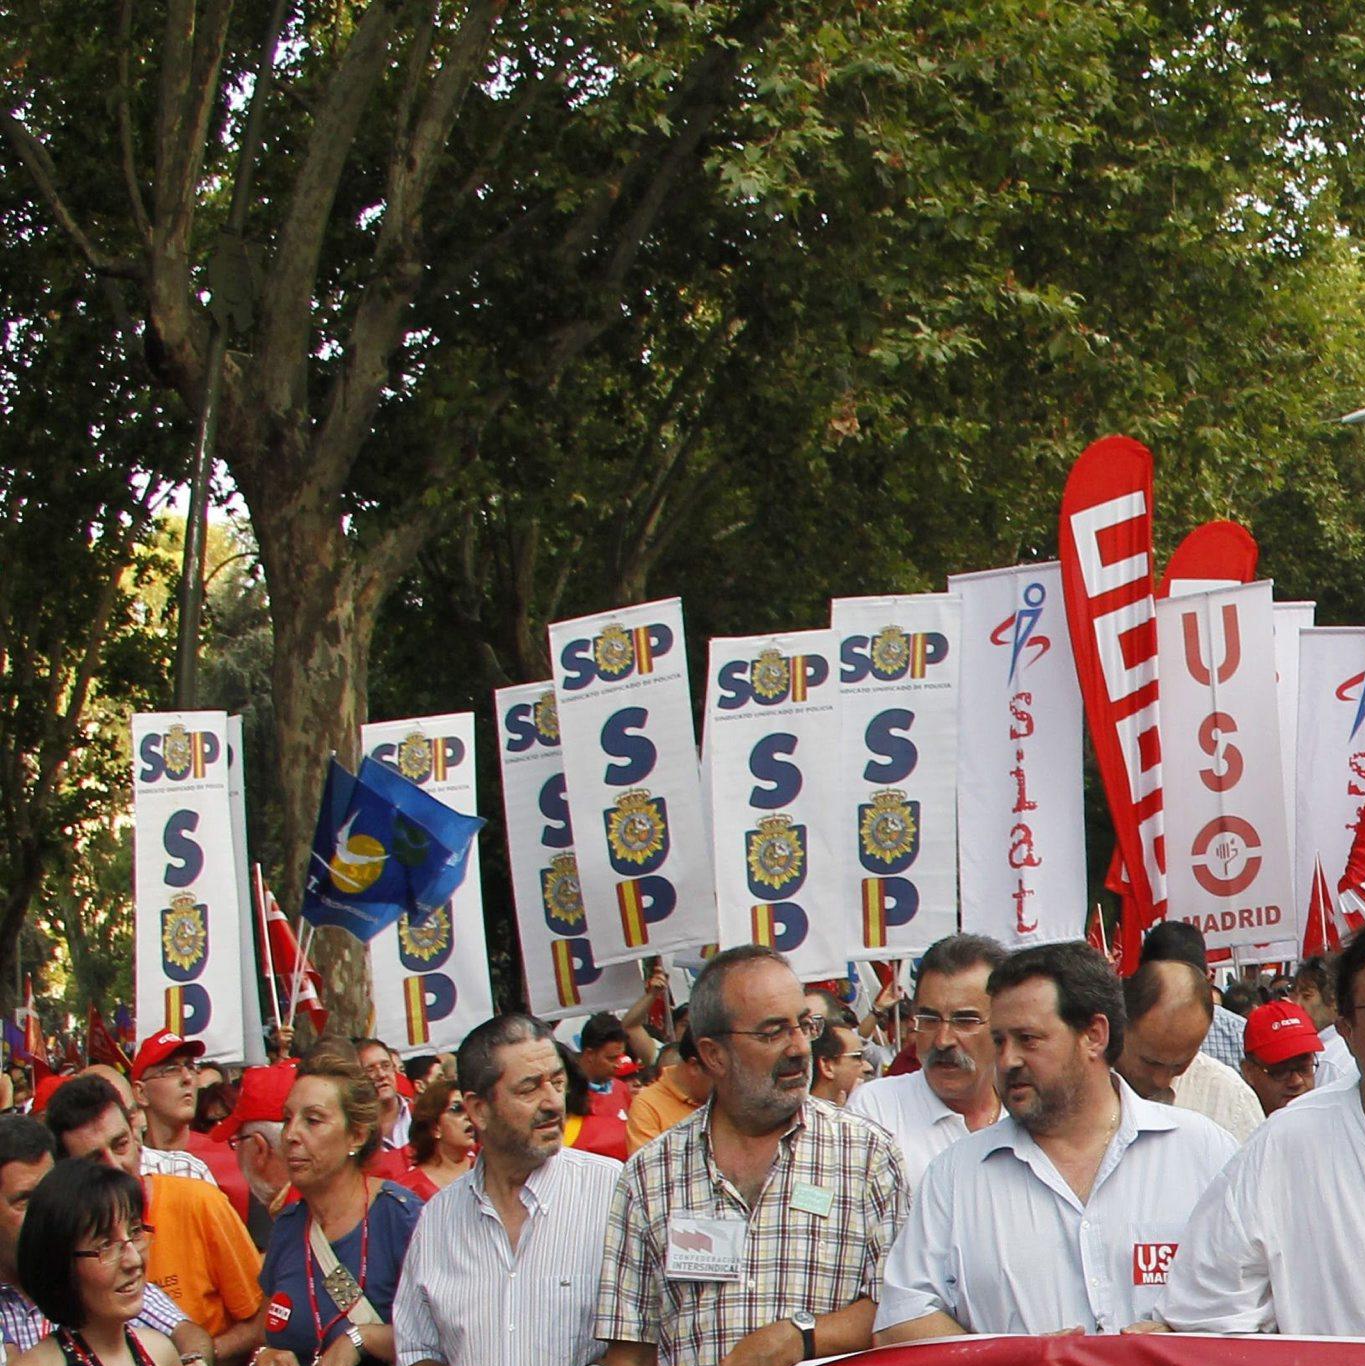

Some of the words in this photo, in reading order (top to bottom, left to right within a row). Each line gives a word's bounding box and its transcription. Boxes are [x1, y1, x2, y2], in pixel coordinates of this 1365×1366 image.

[560, 622, 674, 691] SUP
[717, 653, 829, 710] SUP
[840, 632, 949, 684] SUP
[141, 730, 220, 783] SUP
[505, 702, 561, 752] SU
[601, 706, 678, 948] SUP
[745, 732, 809, 952] SUP
[858, 708, 920, 949] SUP
